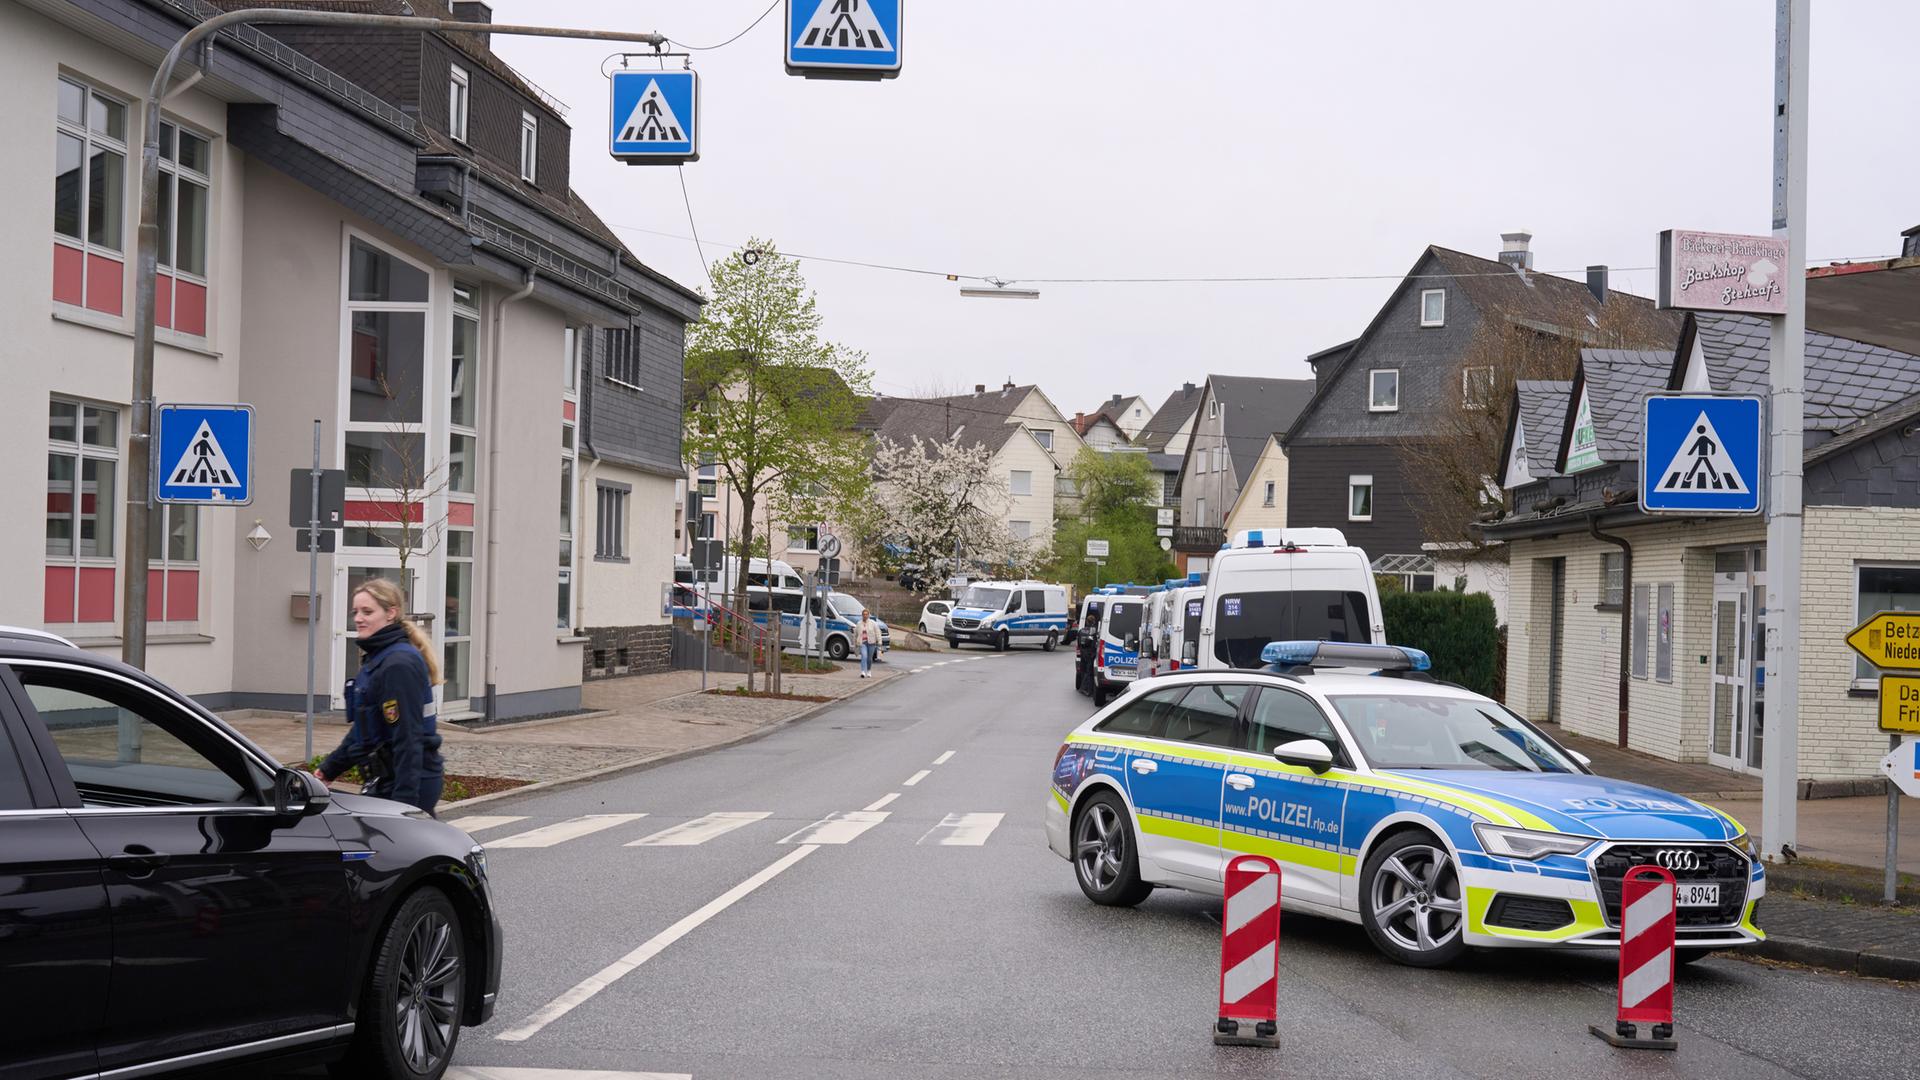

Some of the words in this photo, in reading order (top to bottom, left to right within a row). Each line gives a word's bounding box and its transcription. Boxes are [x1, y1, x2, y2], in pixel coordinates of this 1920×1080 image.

[1680, 262, 1746, 290] Backshop
[1900, 685, 1919, 701] Da
[1899, 704, 1920, 722] Fri
[1563, 799, 1691, 812] POLIZEI
[1690, 886, 1717, 904] 8941
